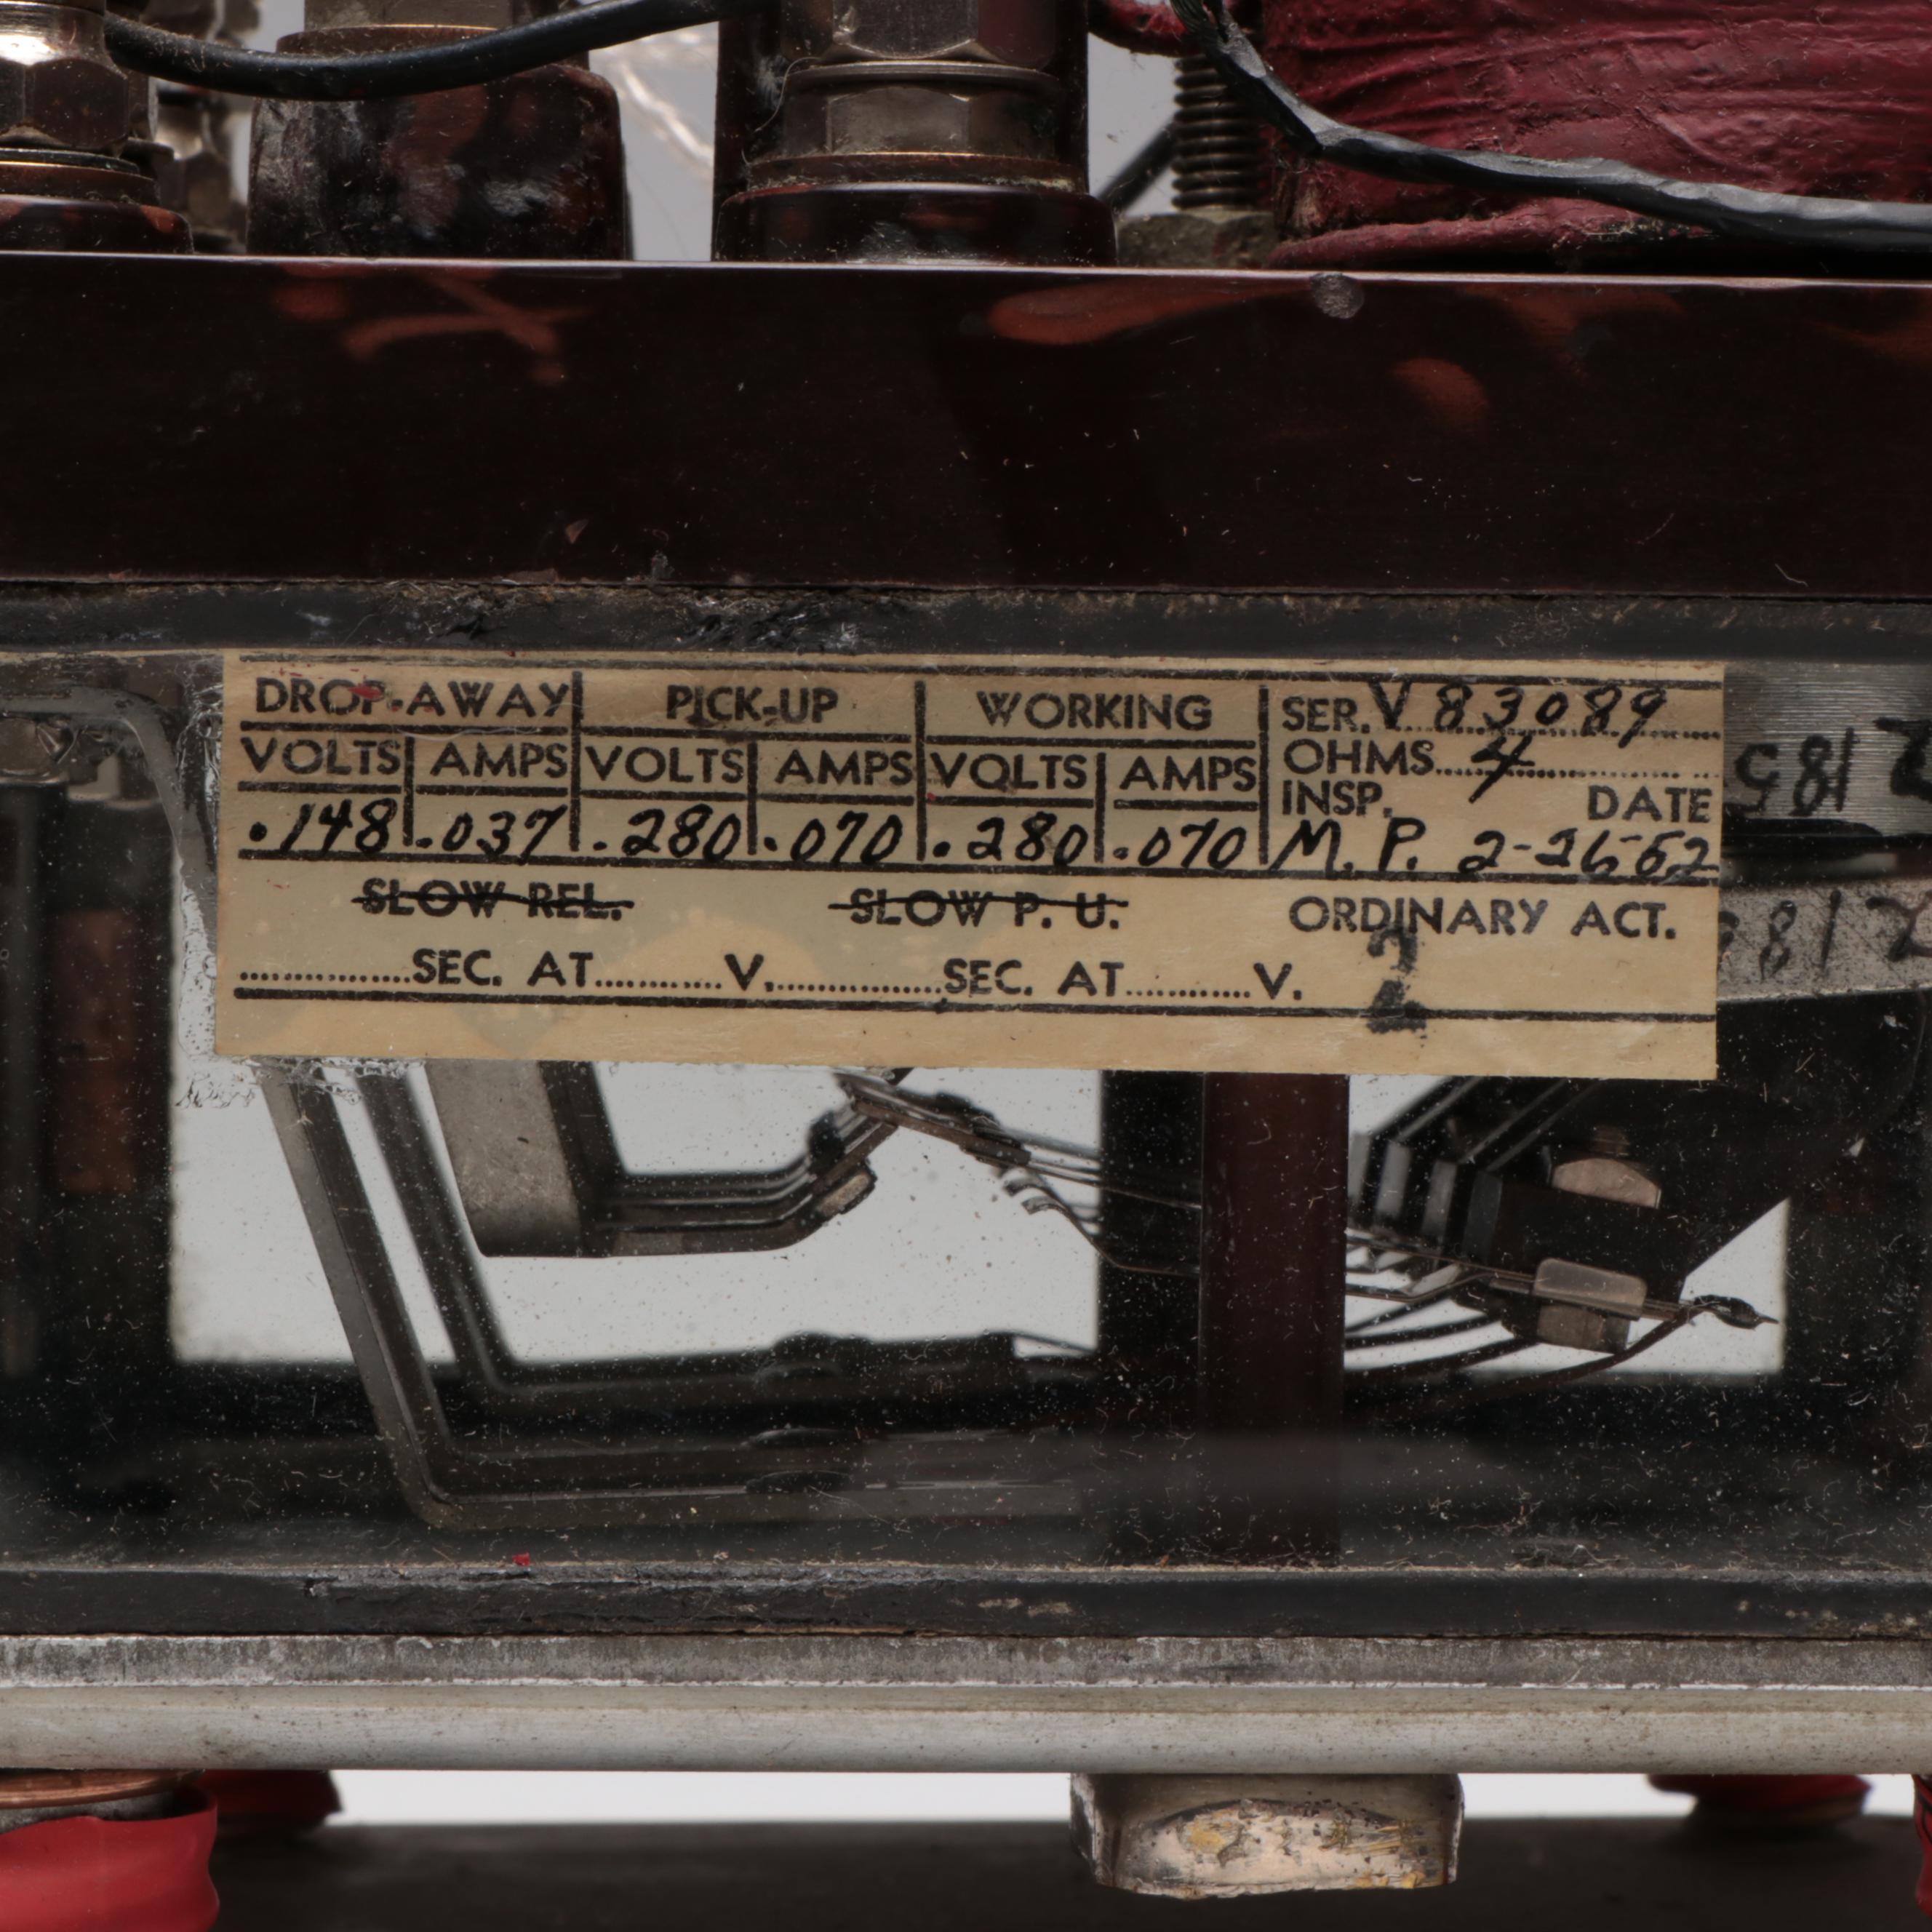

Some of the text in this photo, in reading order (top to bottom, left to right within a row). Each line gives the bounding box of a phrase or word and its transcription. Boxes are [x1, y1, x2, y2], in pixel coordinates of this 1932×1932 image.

[666, 684, 839, 724] PICK-UP
[977, 691, 1213, 731] WORKING
[1282, 696, 1370, 733] SER.
[240, 736, 401, 775] VOLTS
[430, 741, 568, 778] AMPS
[585, 746, 744, 783] VOLTS
[775, 750, 914, 786] AMPS
[930, 752, 1088, 790] VOLTS
[1119, 756, 1257, 791] AMPS
[1283, 739, 1434, 775] OHMS
[1471, 735, 1535, 803] 4
[1282, 779, 1393, 818] INSP.
[1588, 786, 1712, 823] DATE
[249, 799, 398, 853] .148
[416, 805, 568, 866] .037
[593, 804, 741, 861] .280
[764, 810, 903, 866] .070
[933, 811, 1088, 869] .280
[1113, 818, 1247, 869] .070
[362, 877, 506, 918] SLOW
[850, 888, 991, 927] SLOW
[1289, 896, 1676, 940] ORDINARY ACT.
[412, 949, 593, 987] SEC. AT
[943, 959, 1125, 997] SEC. AT
[1253, 962, 1303, 1000] V.
